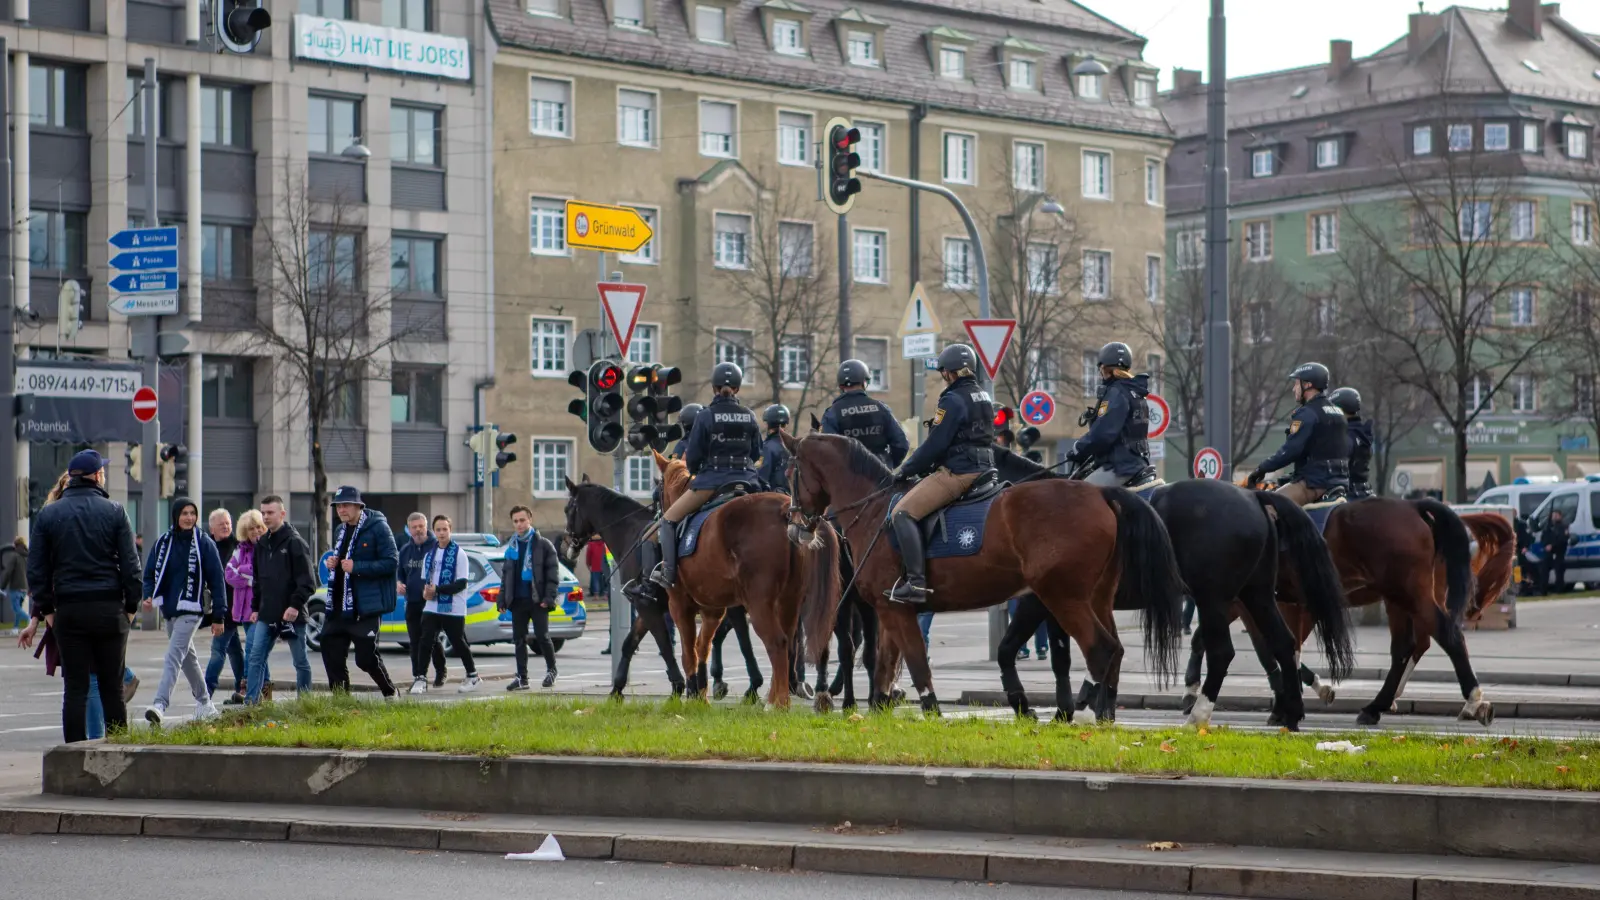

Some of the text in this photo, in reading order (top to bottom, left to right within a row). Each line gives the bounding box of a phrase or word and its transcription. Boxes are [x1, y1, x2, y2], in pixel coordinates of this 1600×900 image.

[351, 34, 384, 57] HAT
[389, 40, 413, 62] DIE
[417, 44, 464, 69] JOBS!
[592, 220, 636, 237] Grünwald
[136, 299, 174, 308] Messe/ICM
[29, 374, 136, 393] 089/4449-17154
[714, 413, 751, 423] POLIZEI
[841, 404, 879, 417] POLIZEI
[28, 420, 72, 434] Potential.
[1200, 458, 1217, 475] 30
[186, 576, 195, 598] TSV
